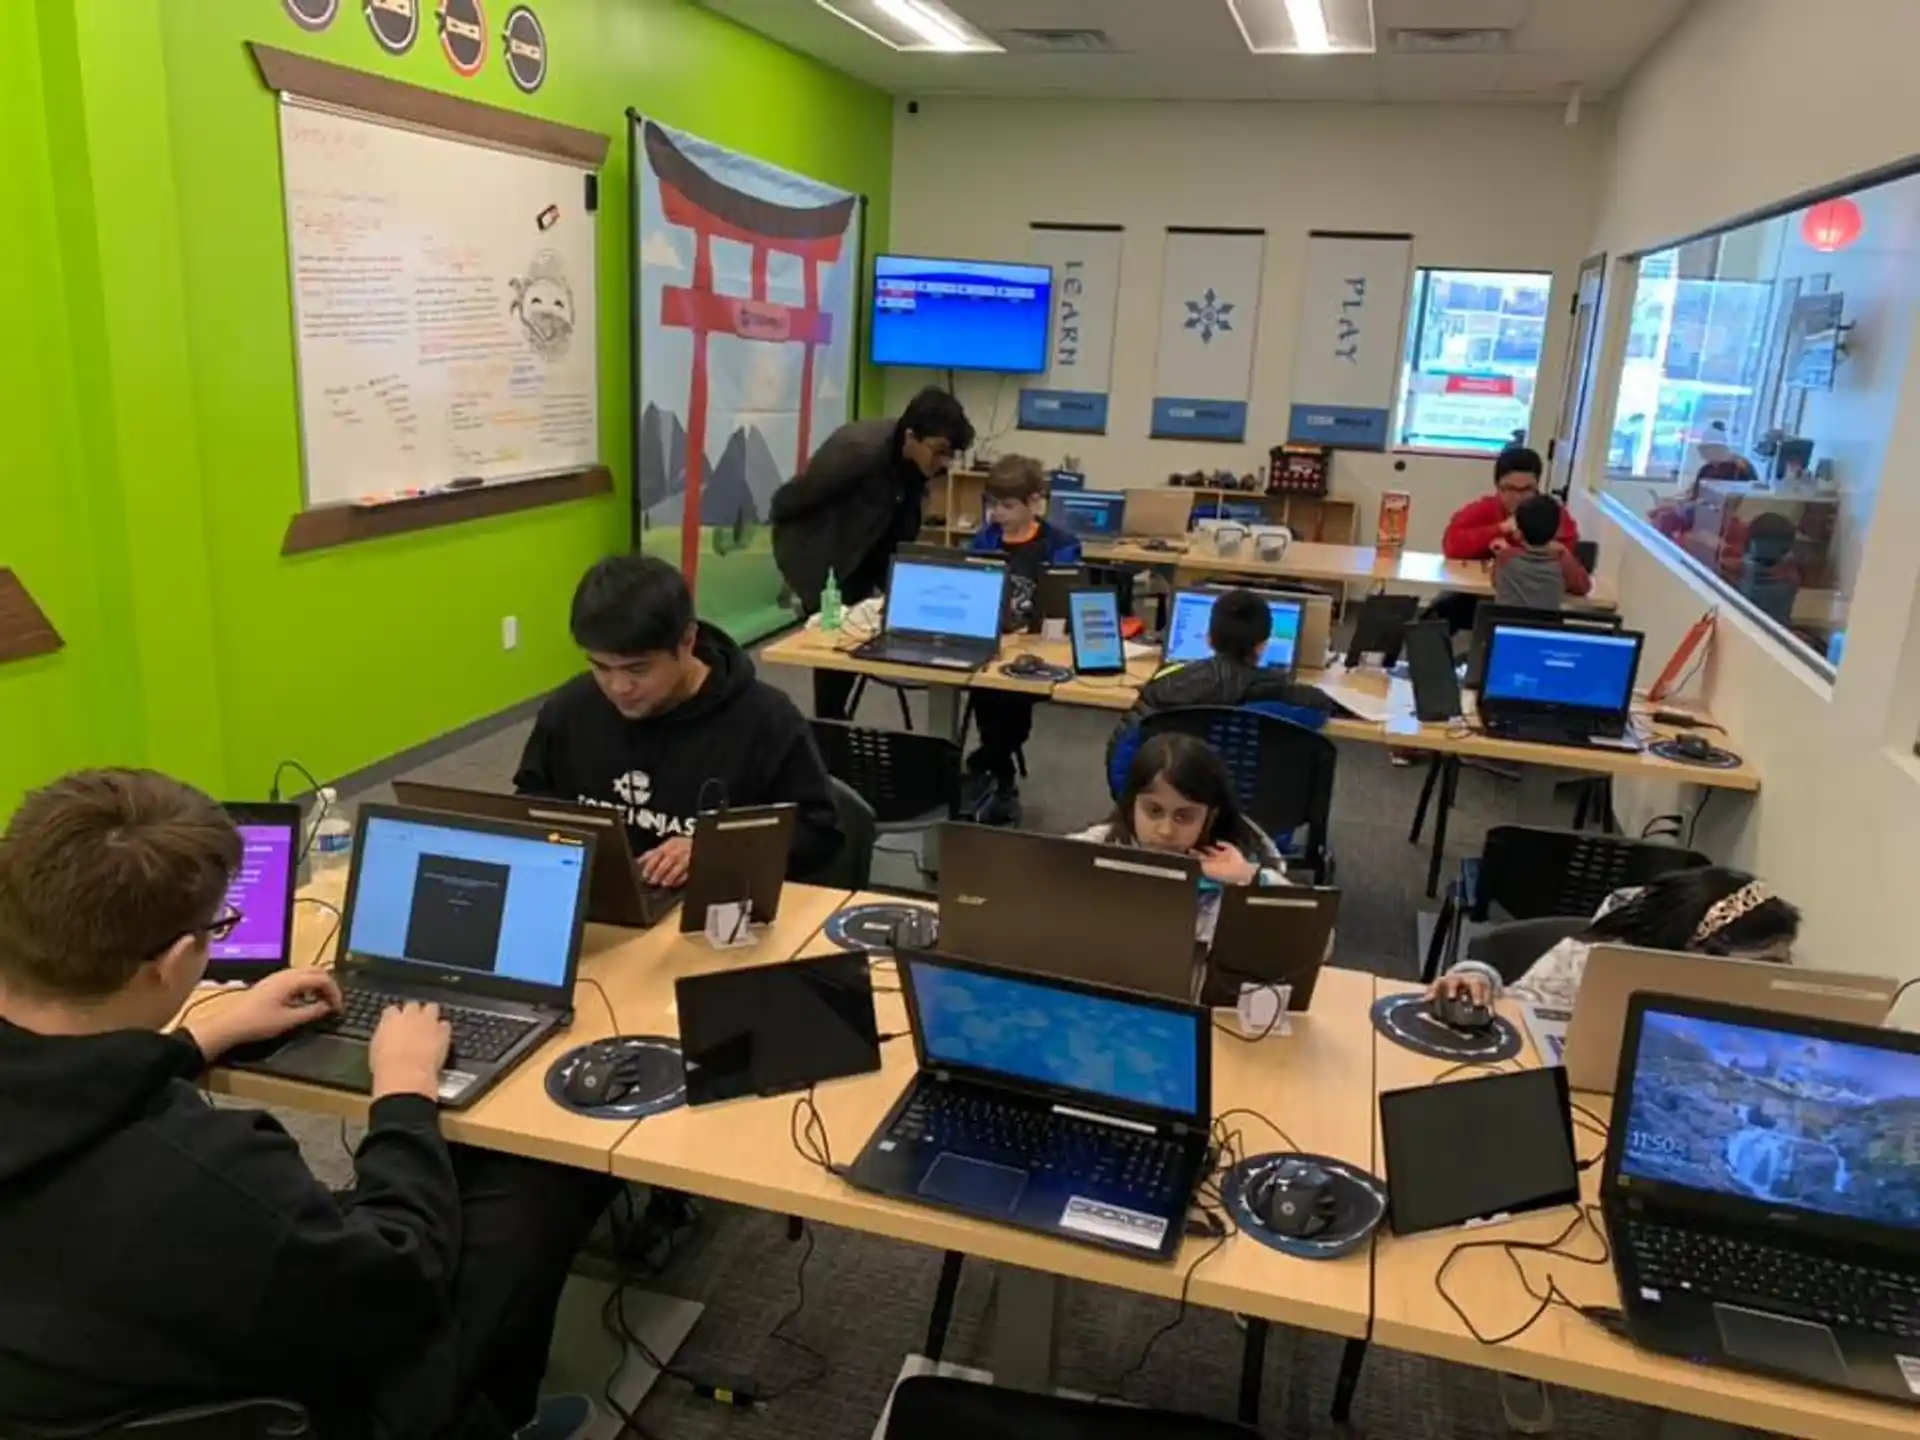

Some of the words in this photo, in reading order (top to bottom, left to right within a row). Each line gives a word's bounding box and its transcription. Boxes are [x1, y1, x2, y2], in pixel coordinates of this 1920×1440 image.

[1058, 261, 1084, 365] LEARN
[1334, 277, 1366, 365] PLAY
[627, 806, 697, 837] NJAS
